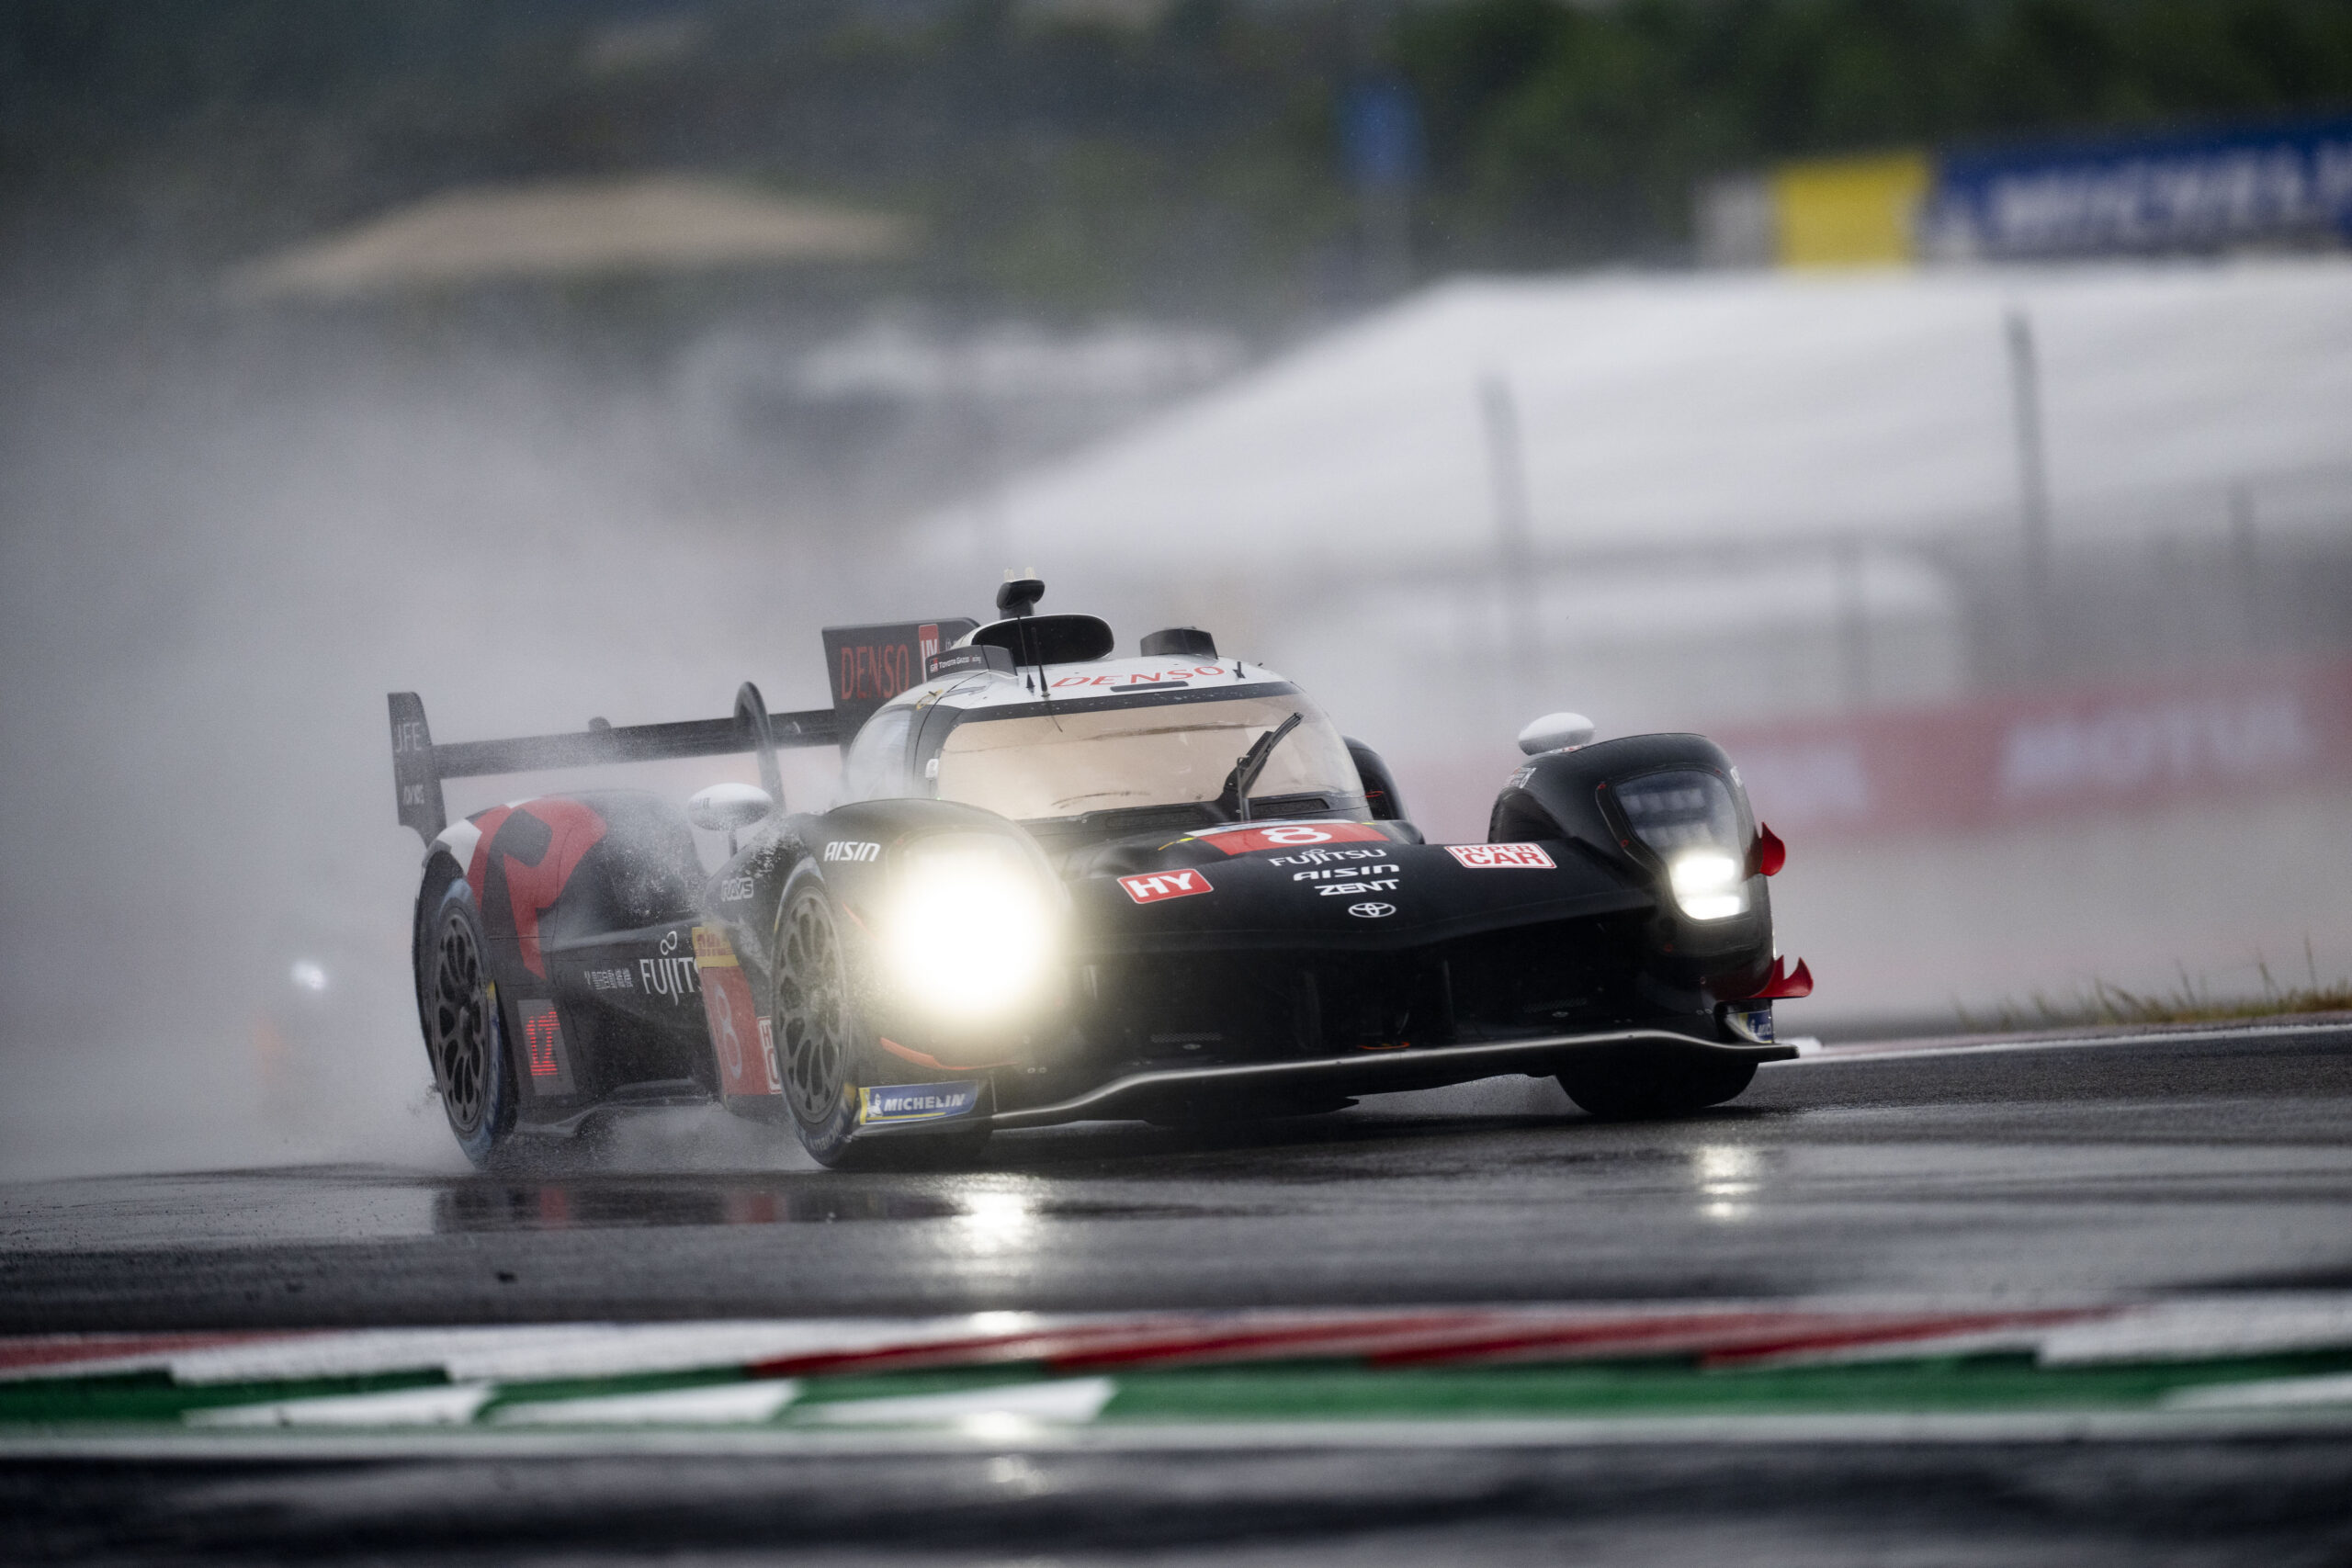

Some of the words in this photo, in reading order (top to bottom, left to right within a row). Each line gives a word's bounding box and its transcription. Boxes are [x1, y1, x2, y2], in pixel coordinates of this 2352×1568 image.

[841, 644, 910, 700] DENSO
[1051, 666, 1226, 687] DENSO
[395, 721, 423, 753] JFE
[1261, 827, 1332, 844] 8
[823, 841, 881, 862] AISIN
[1268, 849, 1387, 867] FUJITSU
[1454, 845, 1535, 854] HYPER
[1464, 852, 1546, 865] CAR
[1293, 863, 1400, 882] AISIN
[1126, 872, 1193, 897] HY
[1314, 878, 1400, 897] ZENT
[639, 957, 703, 1006] FUJIT
[884, 1093, 967, 1111] MICHELIN
